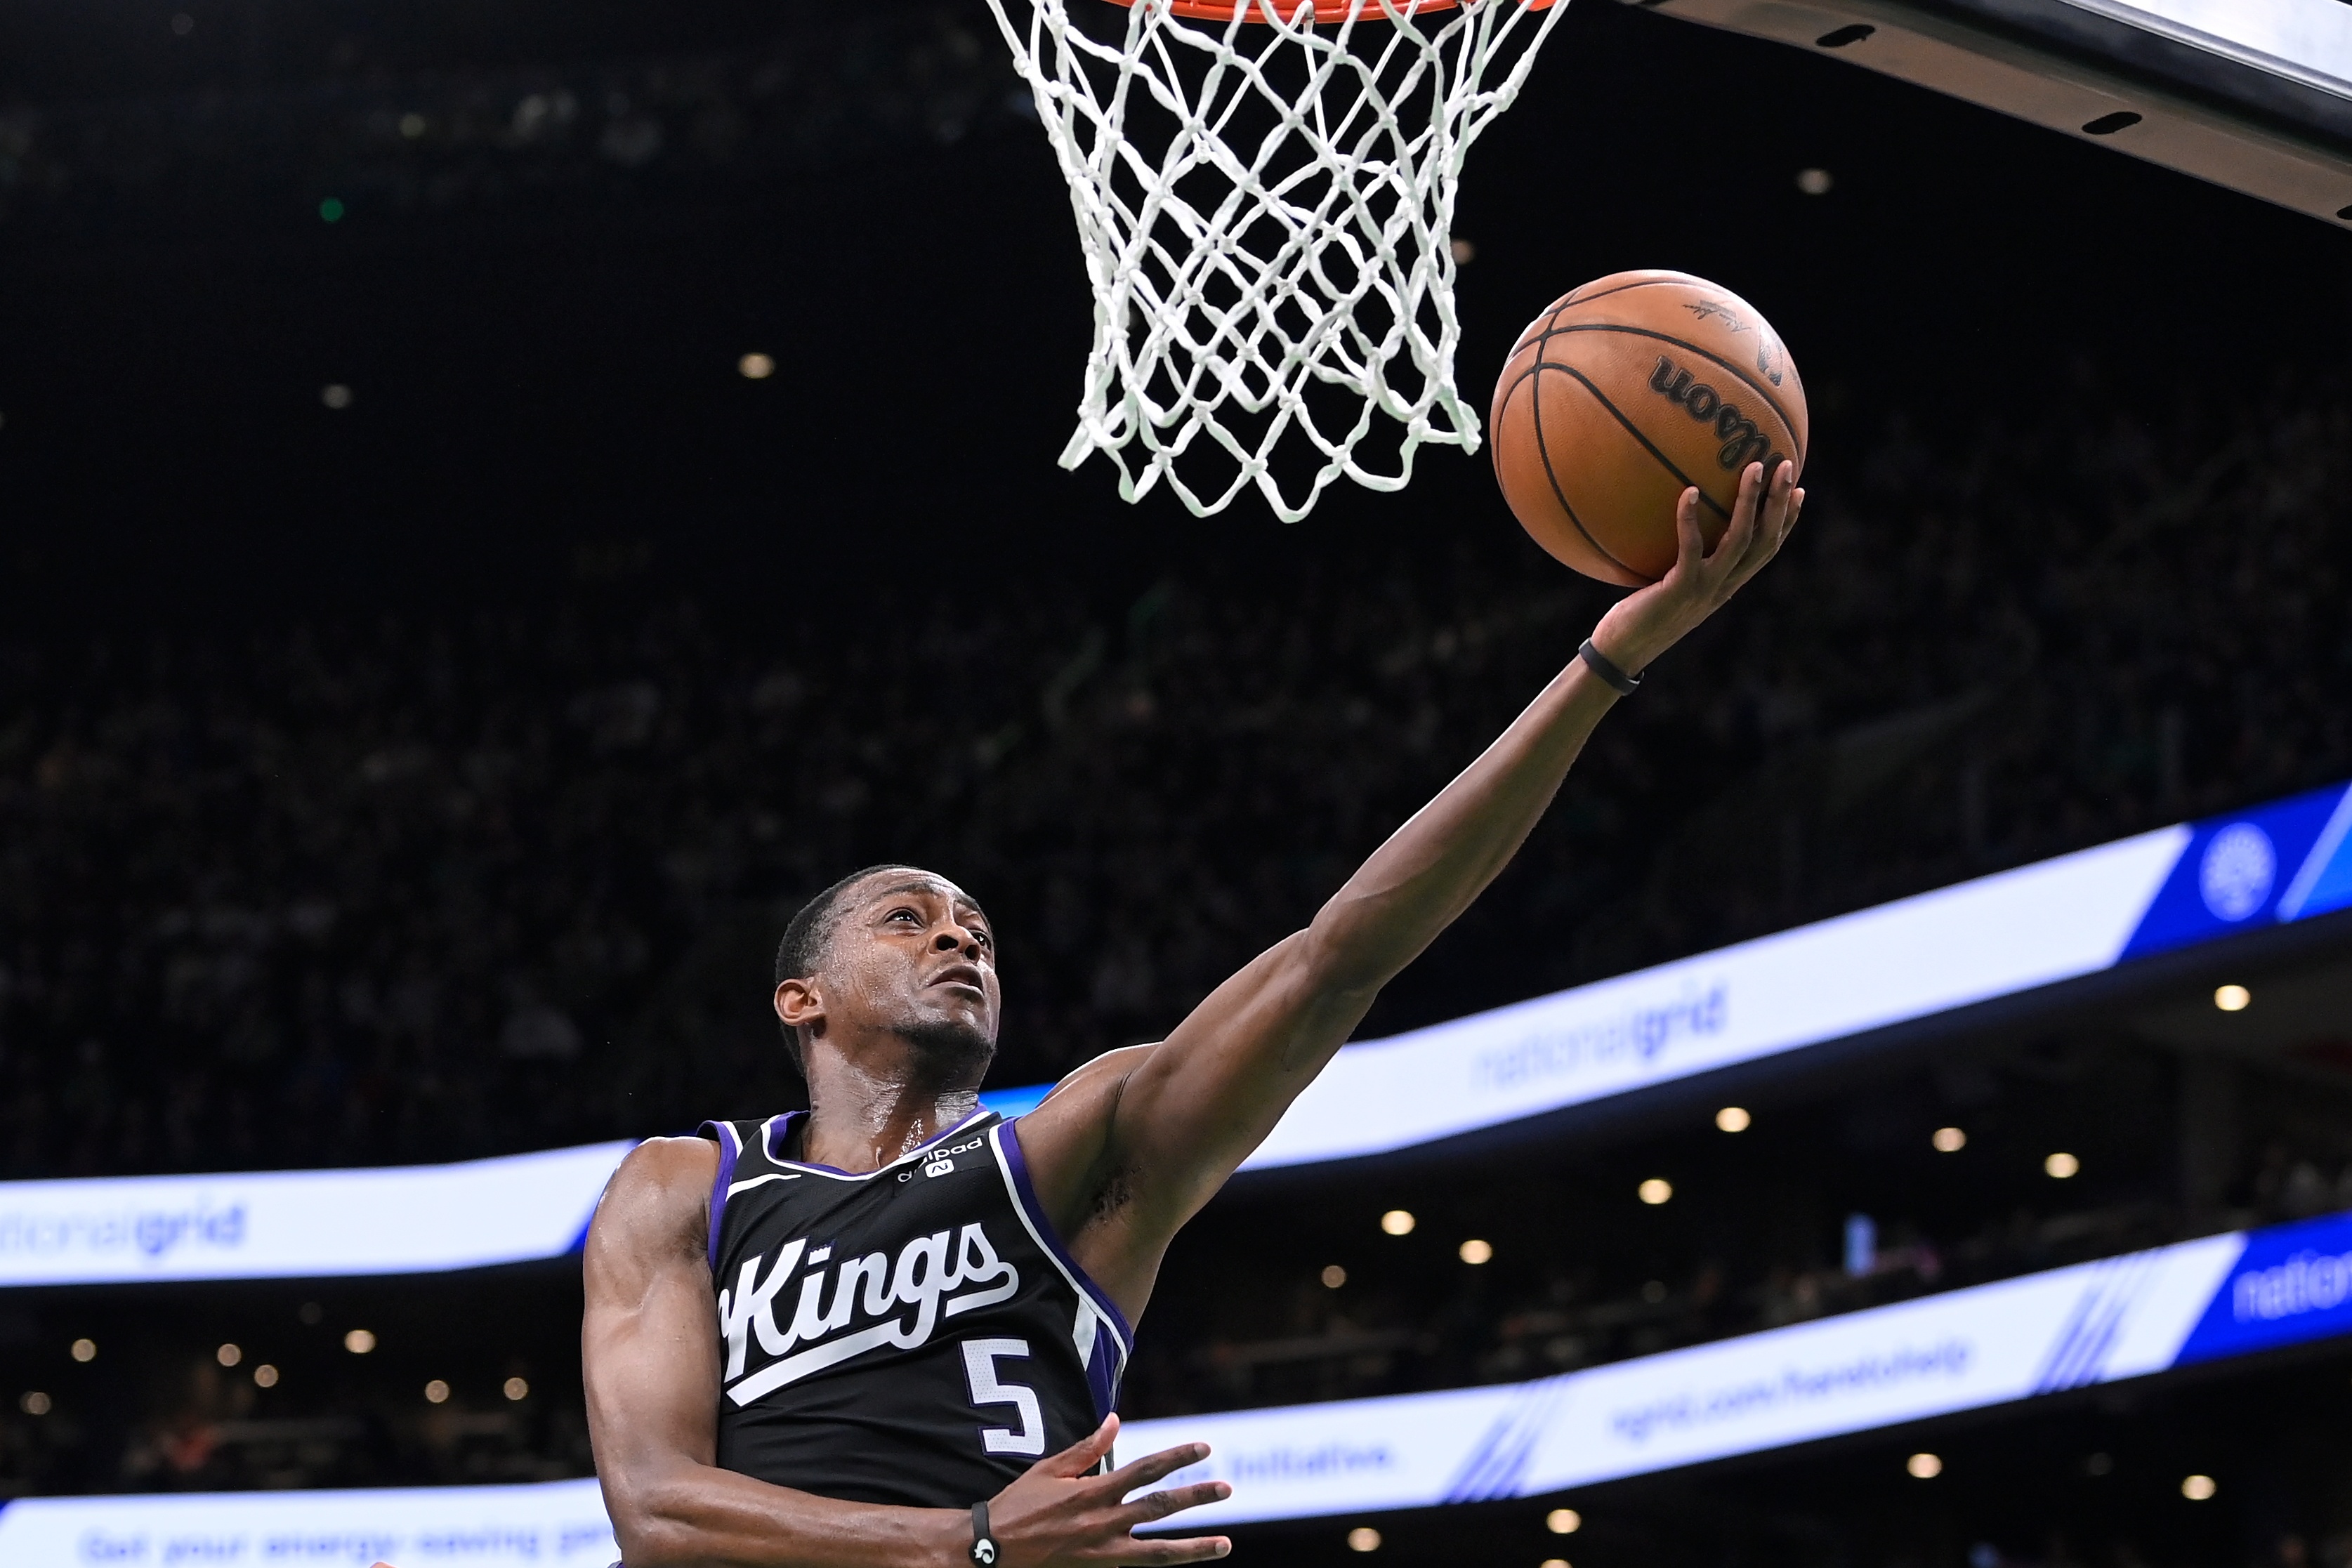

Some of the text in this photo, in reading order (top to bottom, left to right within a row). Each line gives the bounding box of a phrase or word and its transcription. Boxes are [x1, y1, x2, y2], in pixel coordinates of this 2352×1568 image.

[1647, 353, 1785, 483] ilson
[719, 1222, 1019, 1406] Kings
[960, 1338, 1044, 1456] 5
